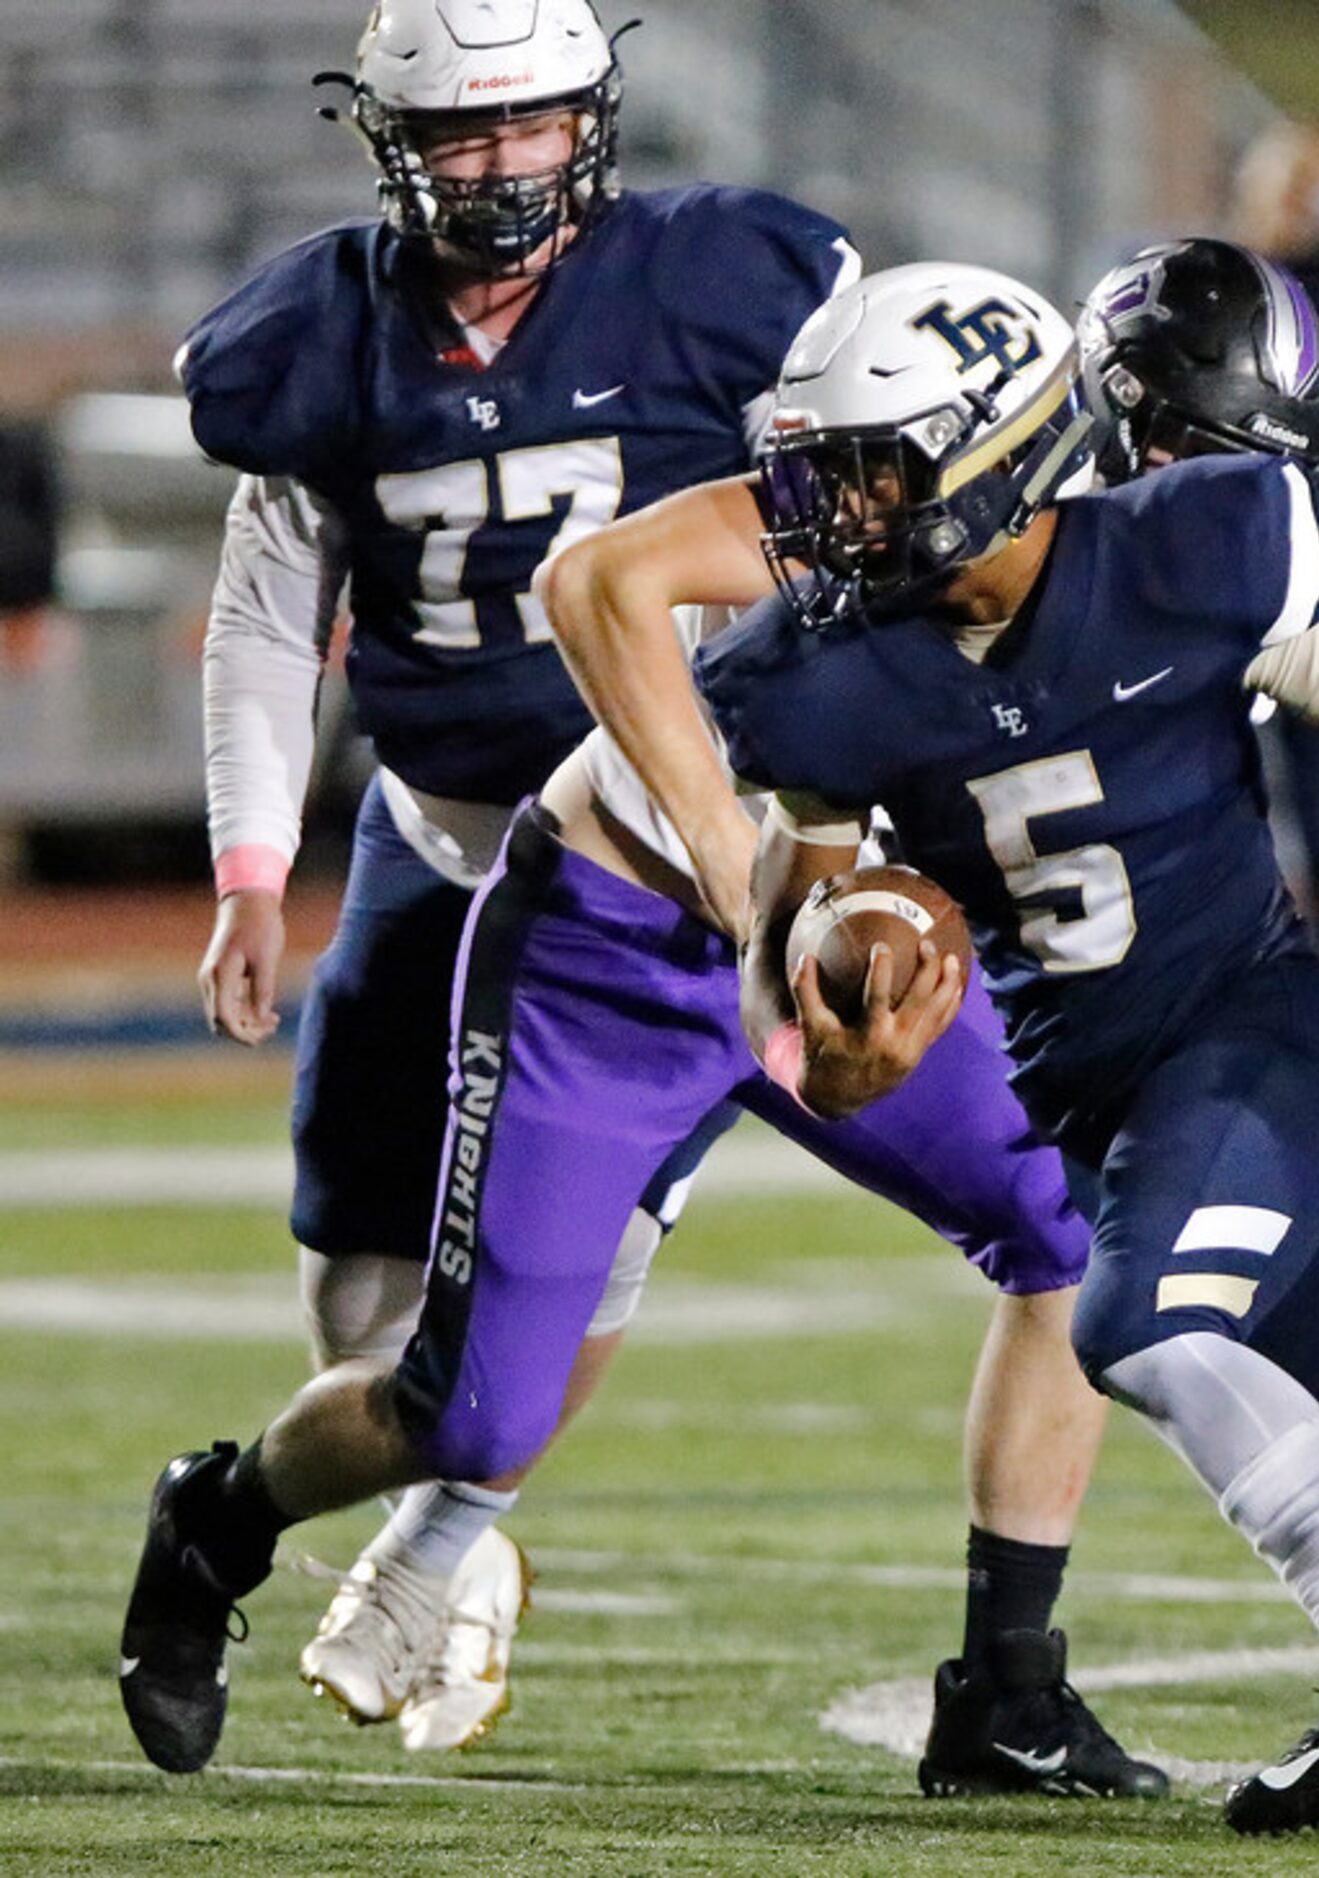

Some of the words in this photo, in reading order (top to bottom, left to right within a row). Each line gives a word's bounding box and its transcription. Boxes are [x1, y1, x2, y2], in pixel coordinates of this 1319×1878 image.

[907, 296, 1044, 375] LE
[466, 396, 501, 431] LE
[375, 436, 625, 648] 77
[990, 702, 1029, 739] LE
[965, 748, 1138, 974] 5
[439, 1029, 502, 1286] KNIGHTS
